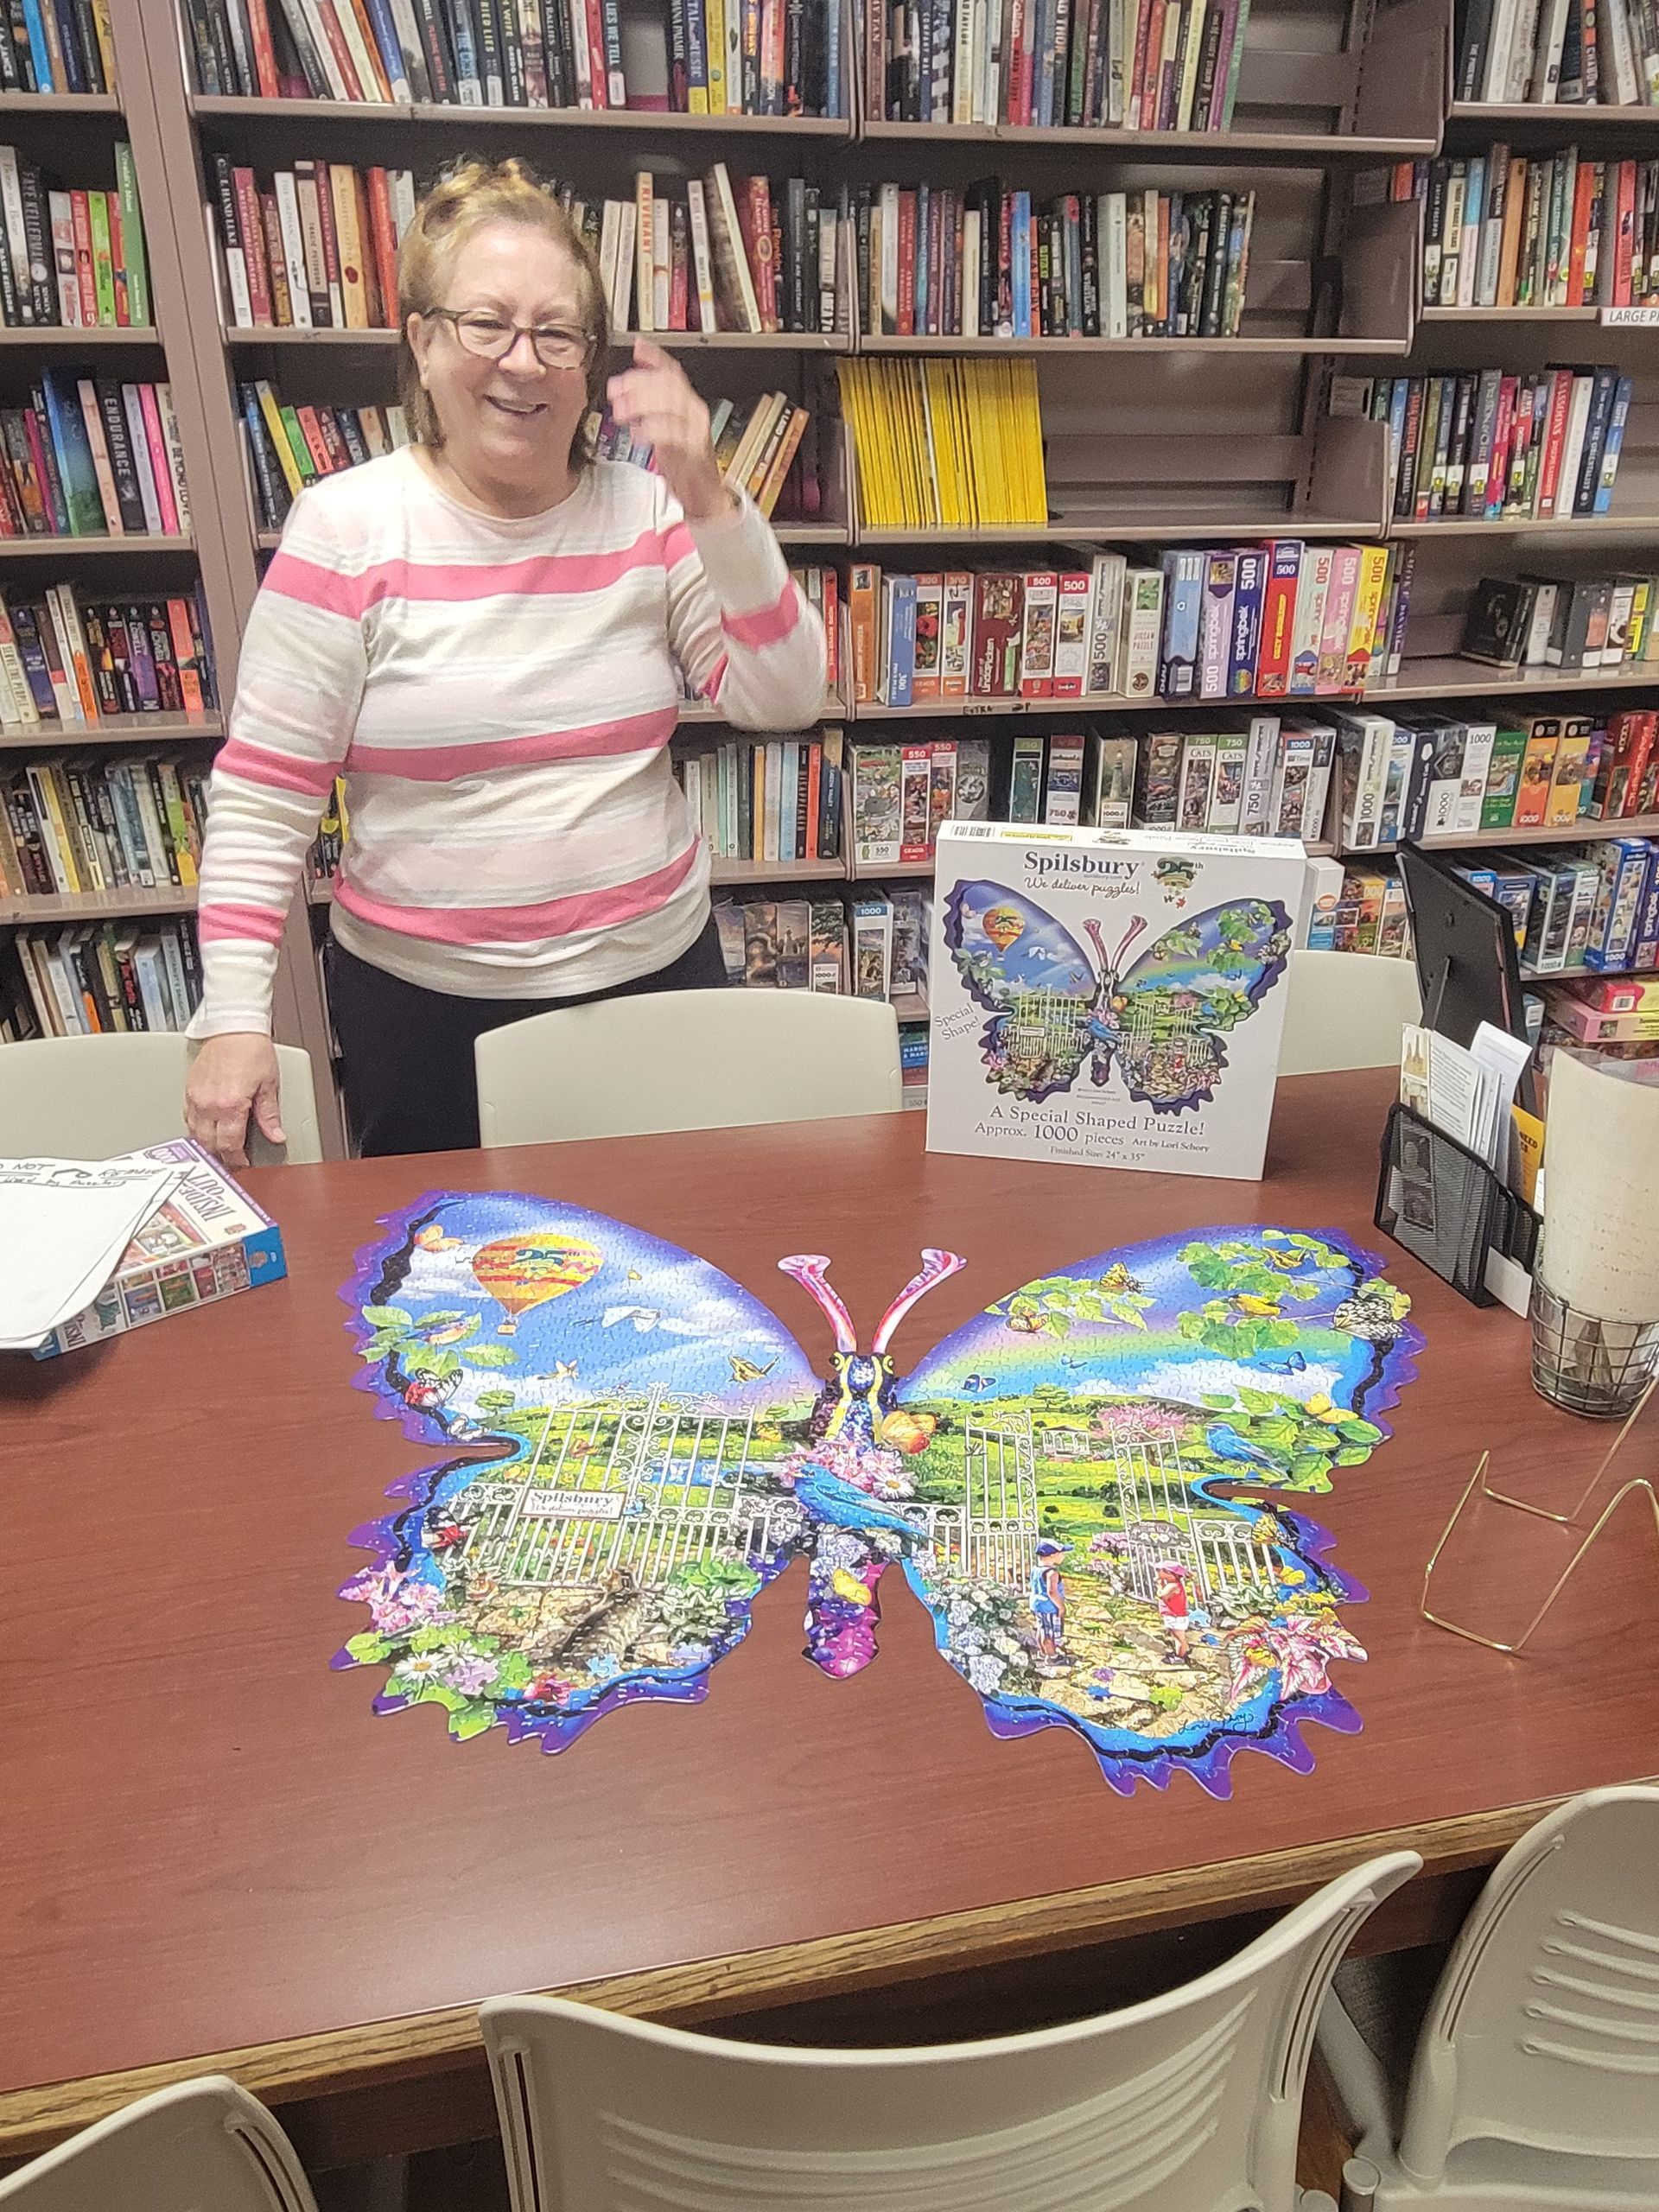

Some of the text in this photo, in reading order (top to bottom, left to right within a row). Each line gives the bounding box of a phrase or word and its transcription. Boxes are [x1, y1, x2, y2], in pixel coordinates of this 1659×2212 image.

[504, 9, 514, 37] WIFE
[606, 3, 620, 66] LIES WE TELL
[483, 29, 494, 52] LIES
[673, 26, 684, 60] PALMER
[690, 41, 702, 78] MUSIC
[221, 188, 235, 217] HAND
[226, 219, 238, 247] LUKE
[642, 188, 652, 254] REVENANT
[821, 291, 835, 317] AREA
[1609, 310, 1647, 323] LARGE
[105, 397, 130, 476] ENDURANCE
[172, 448, 185, 485] BEYOND
[1033, 577, 1052, 587] 500
[1276, 563, 1296, 575] 500
[1315, 557, 1329, 584] 500
[1341, 557, 1356, 585] 500
[1370, 556, 1384, 584] 500
[1064, 580, 1086, 591] 500
[1236, 558, 1256, 662] 500 springbok
[130, 621, 143, 656] LOWELL
[1093, 633, 1107, 660] 500
[1205, 605, 1220, 693] springbok 500
[3, 646, 28, 708] SERVE THE PEOPLE
[899, 673, 907, 691] 300
[934, 743, 951, 752] 550
[1226, 738, 1243, 747] 750
[1290, 741, 1311, 749] 1000
[1470, 734, 1492, 745] 1000
[908, 750, 926, 759] 550
[1190, 749, 1211, 759] CATS
[1222, 752, 1243, 760] CATS
[1246, 793, 1261, 817] 750
[1360, 793, 1375, 821] 1000
[1519, 815, 1539, 823] 1000
[1024, 851, 1140, 880] Spilsbury
[1024, 876, 1141, 898] We deliver puzzles!
[934, 1003, 975, 1029] Special
[941, 1016, 981, 1040] Shape!
[989, 1105, 1205, 1135] A Special Shaped Puzzle!
[975, 1121, 1210, 1153] Approx. 1000 pieces Art by Lori Schory
[1519, 1131, 1539, 1149] NEED
[1051, 1146, 1085, 1157] Finished
[178, 1180, 237, 1223] INSIDE
[533, 1492, 614, 1507] Spilsbury
